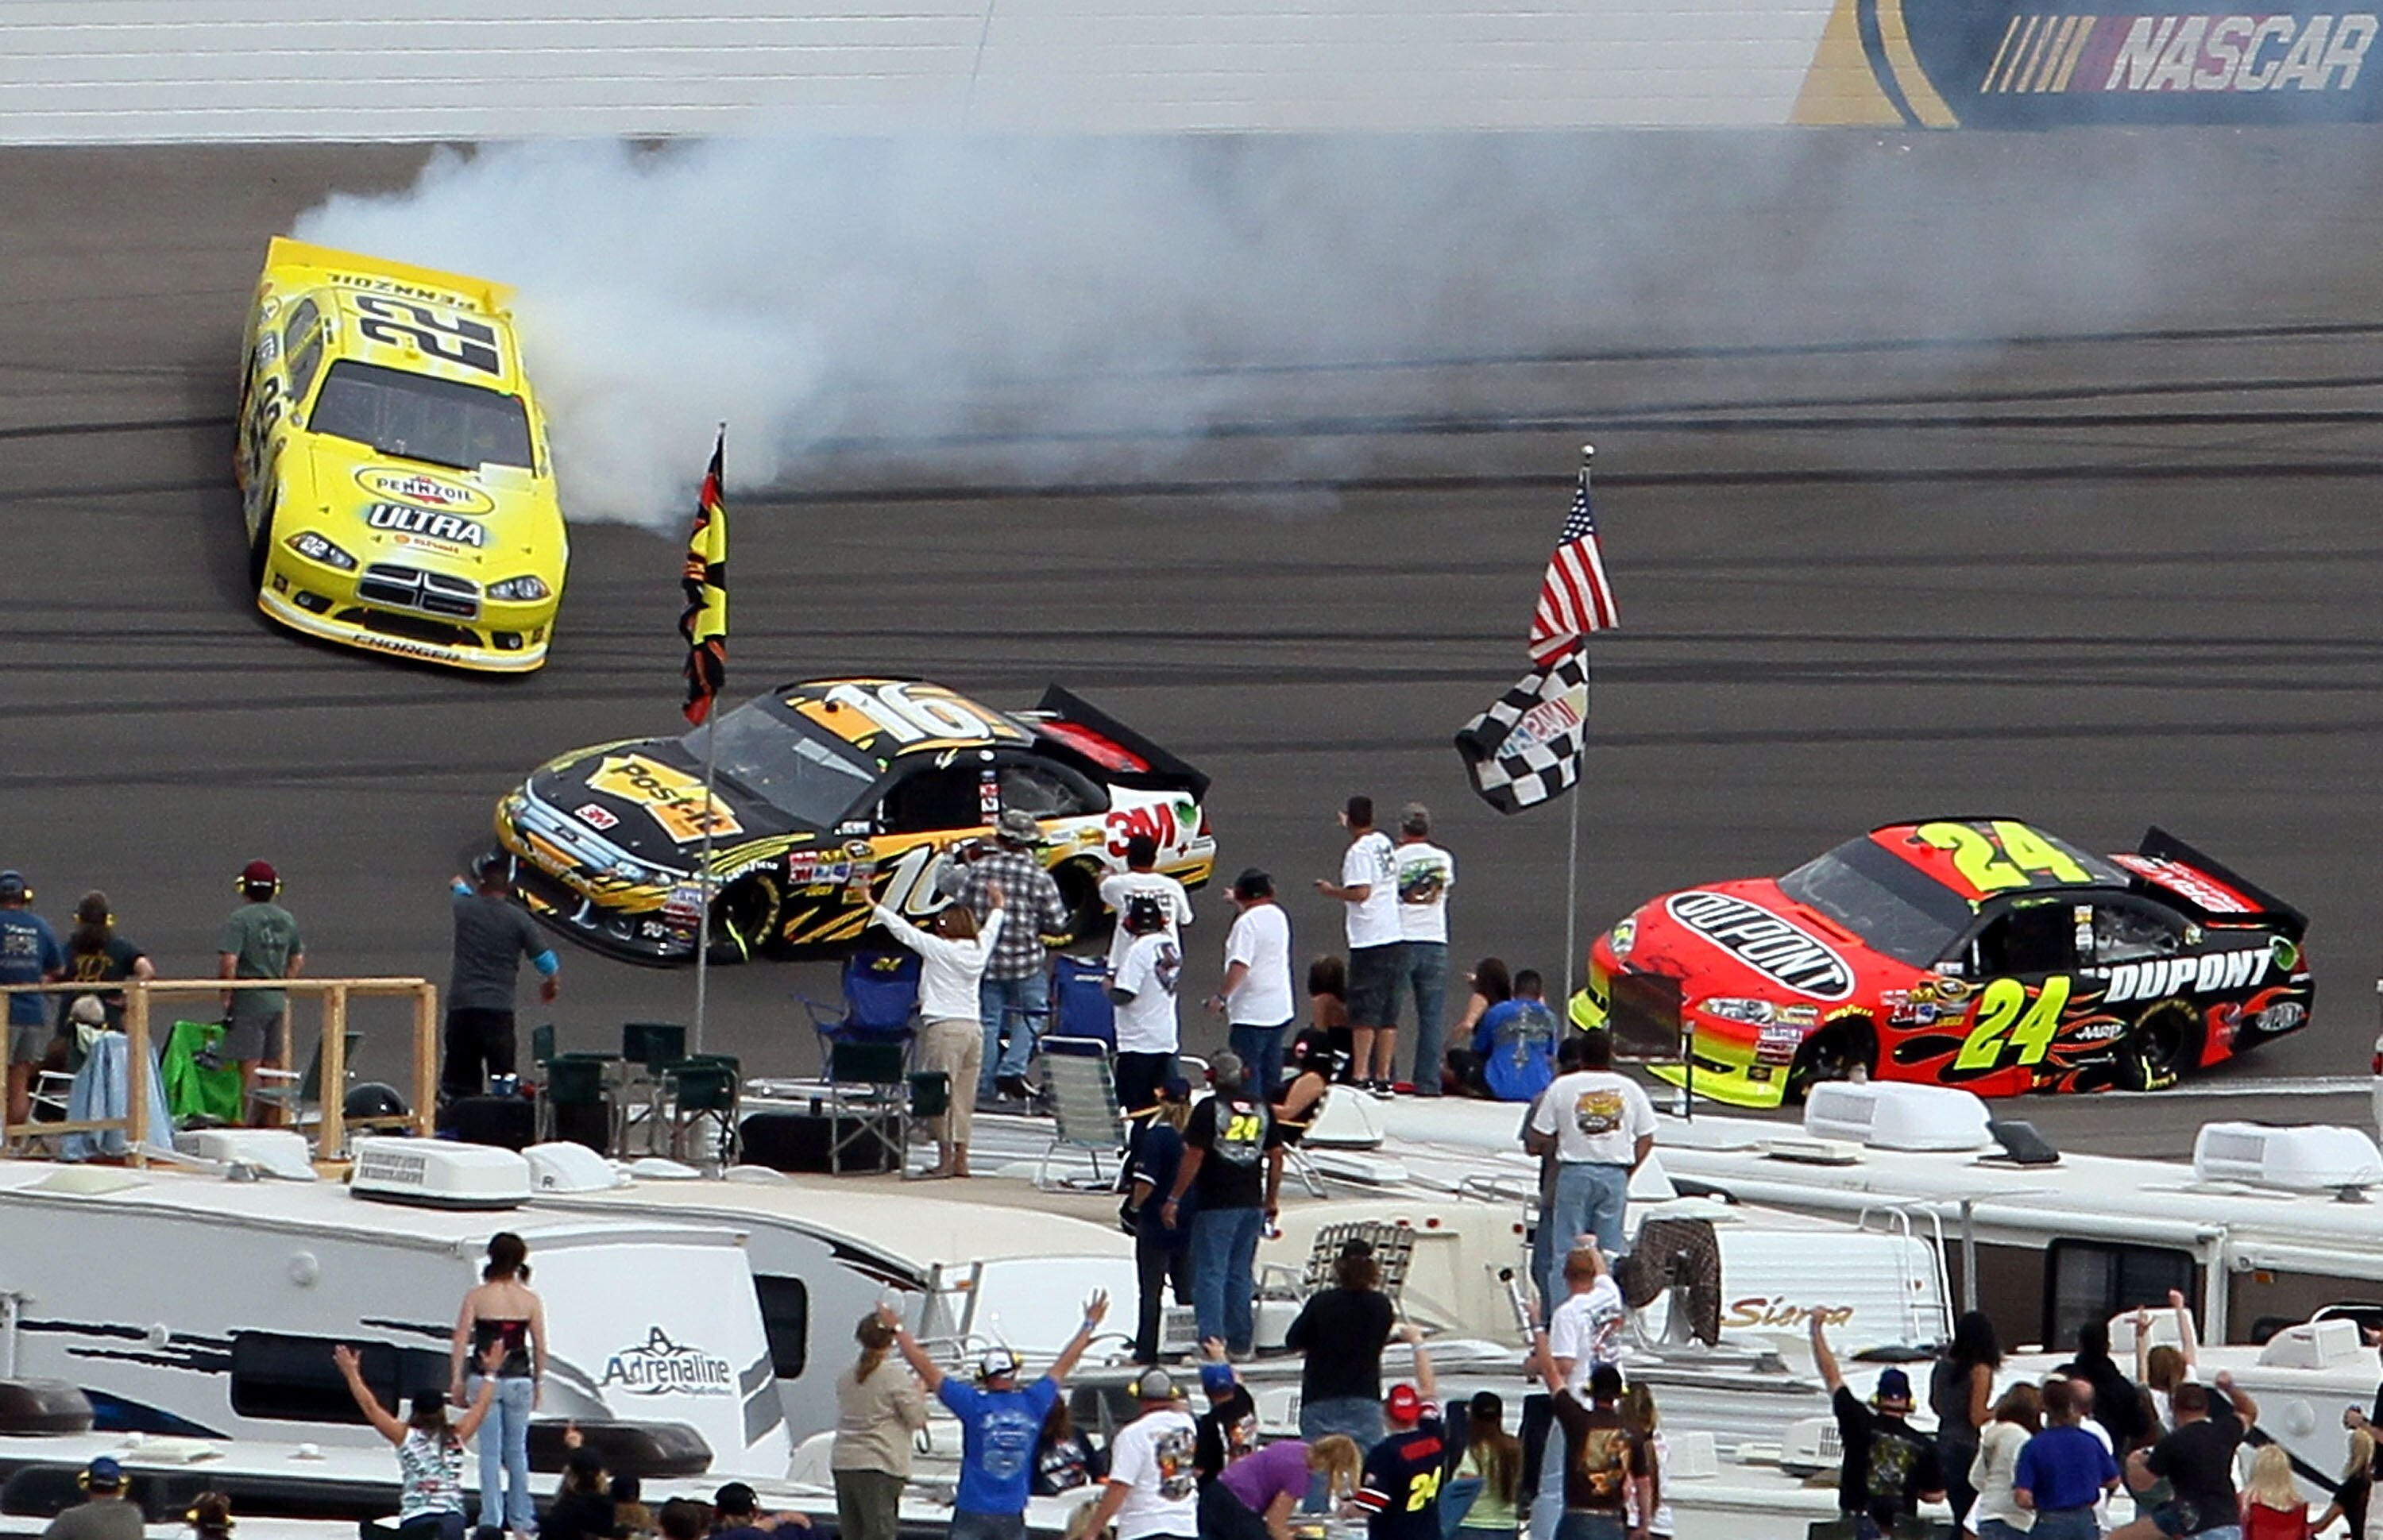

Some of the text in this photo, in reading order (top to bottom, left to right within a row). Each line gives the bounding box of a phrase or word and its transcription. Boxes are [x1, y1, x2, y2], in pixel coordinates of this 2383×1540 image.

[2105, 14, 2378, 91] NASCAR
[326, 272, 478, 311] PENNZOIL
[354, 295, 504, 377] 22
[376, 477, 474, 502] PENNZOIL
[300, 535, 329, 557] 22
[369, 504, 483, 547] ULTRA
[824, 681, 994, 743] 16
[581, 805, 615, 827] 3M
[1916, 820, 2093, 892] 24
[2103, 948, 2274, 1003] DUPONT
[1952, 975, 2071, 1071] 24
[2073, 1024, 2122, 1040] AARP
[1225, 1114, 1259, 1141] 24
[597, 1355, 730, 1386] Adrenaline
[1406, 1465, 1442, 1512] 24
